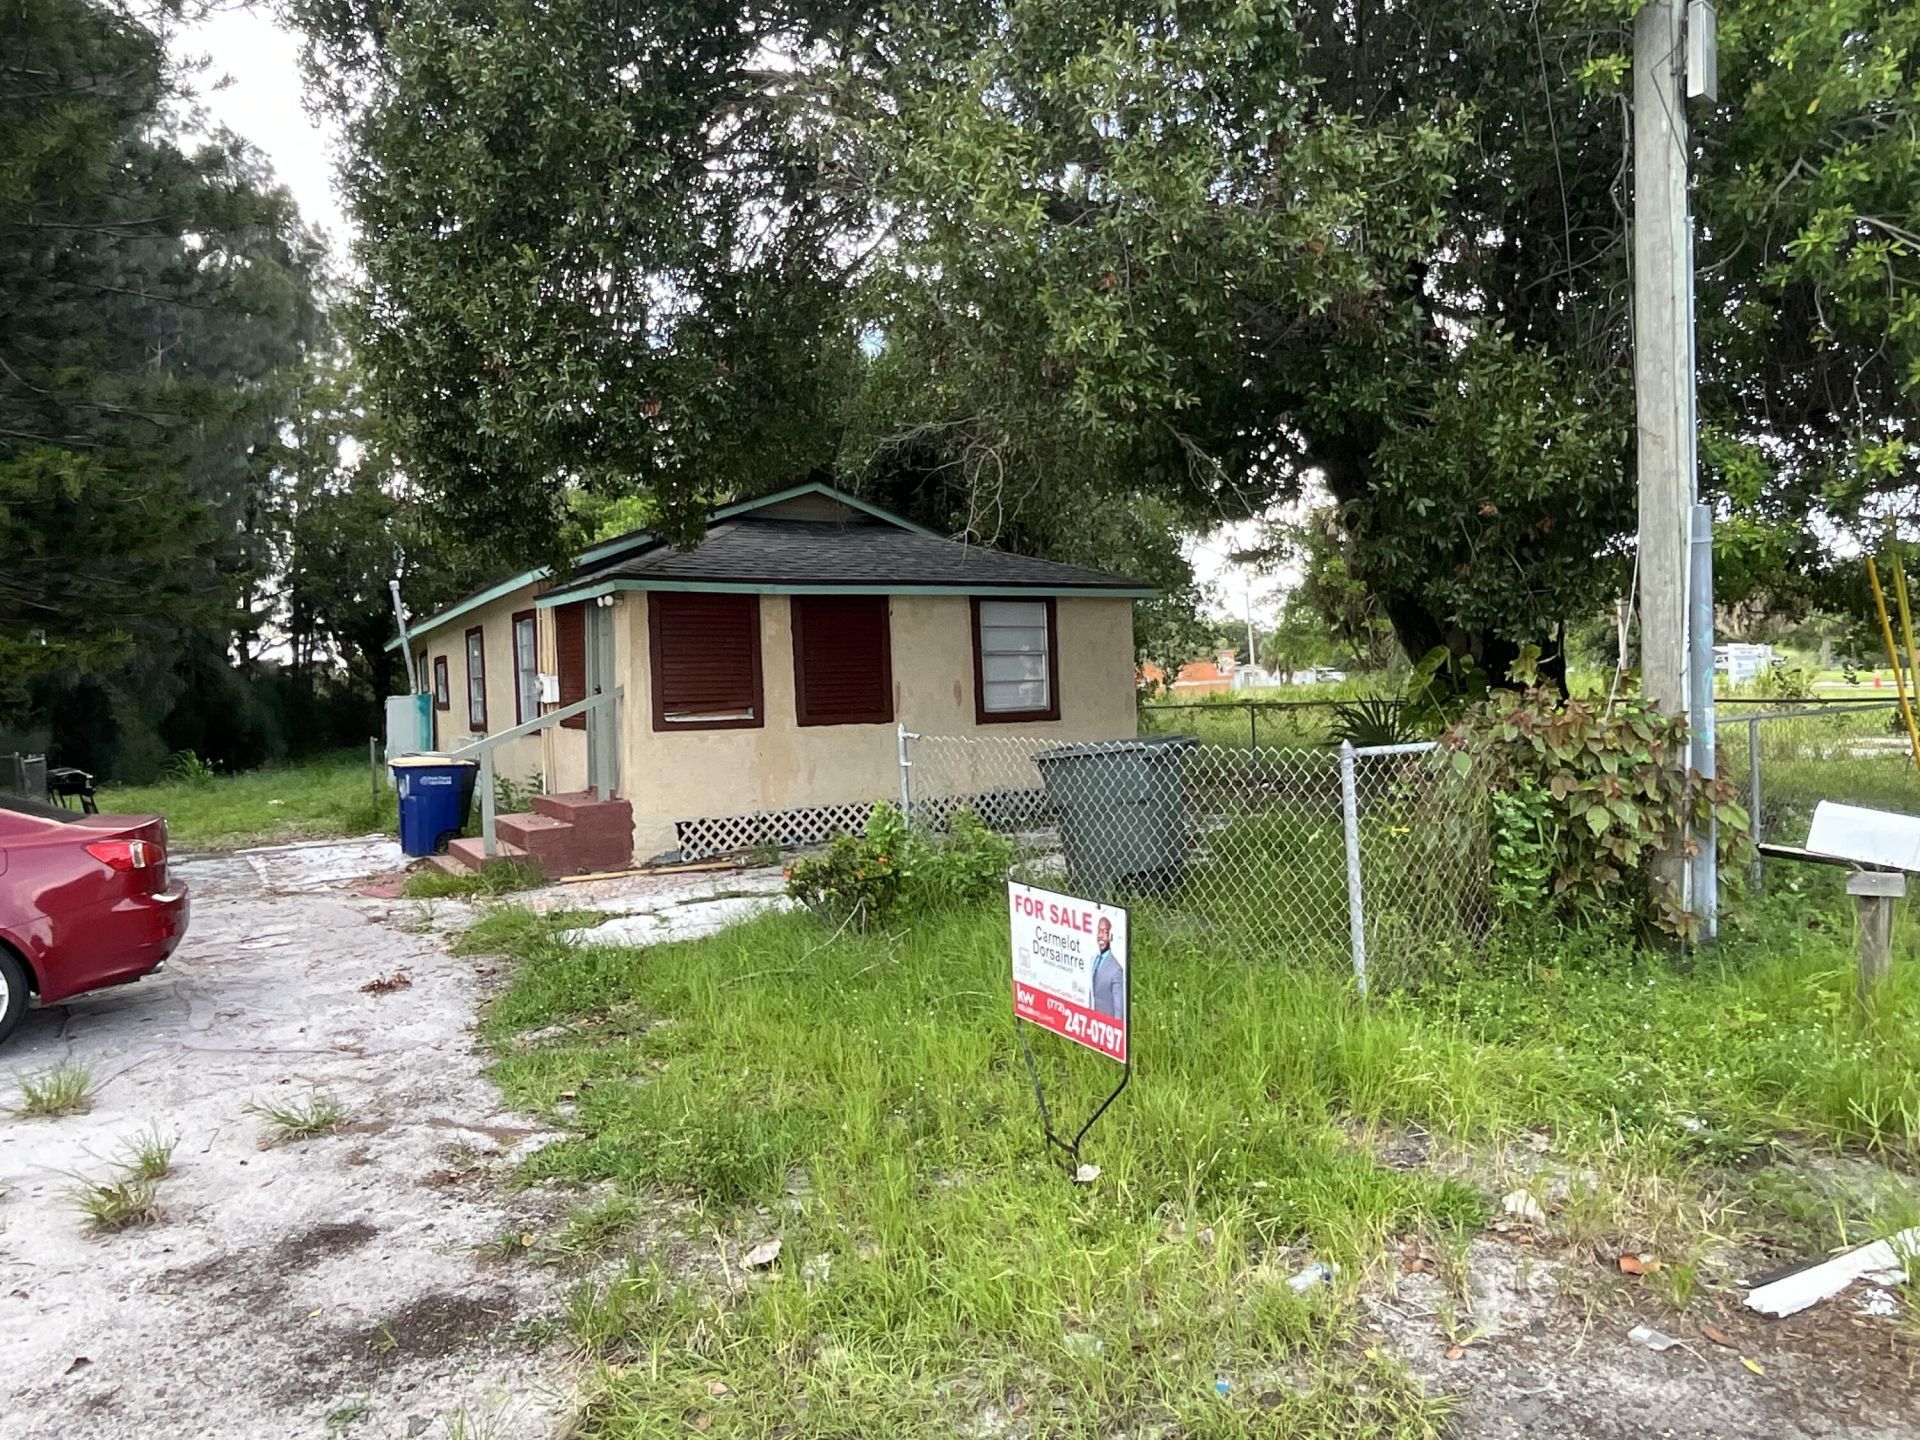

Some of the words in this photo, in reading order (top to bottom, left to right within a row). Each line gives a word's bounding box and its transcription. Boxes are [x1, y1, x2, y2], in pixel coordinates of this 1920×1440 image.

[1015, 894, 1045, 921] FOR
[1050, 904, 1093, 934] SALE
[1035, 926, 1081, 954] Carmelot
[1046, 997, 1066, 1016] (772)
[1064, 1009, 1123, 1053] 247-0797
